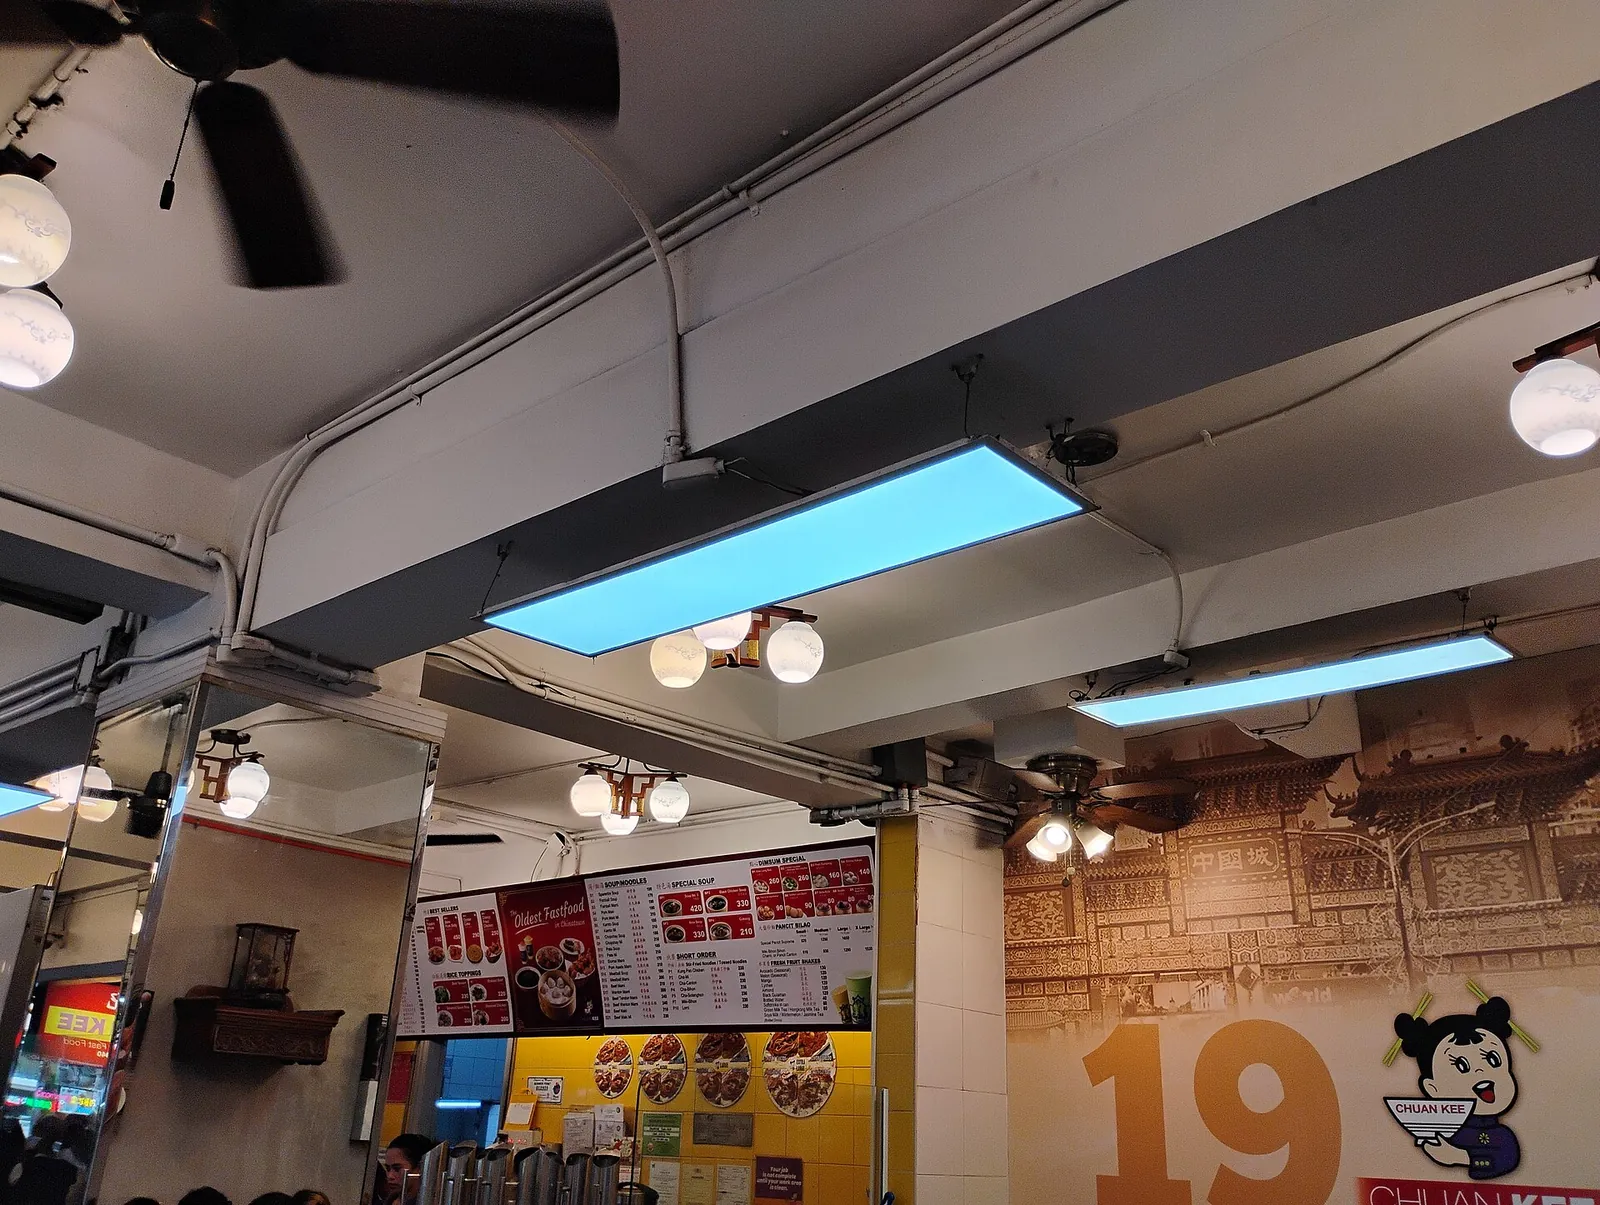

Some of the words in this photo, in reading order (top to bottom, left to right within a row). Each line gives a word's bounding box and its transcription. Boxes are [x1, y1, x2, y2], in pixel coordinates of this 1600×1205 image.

[672, 879, 697, 888] SPECIAL
[515, 911, 542, 928] Oldest
[544, 896, 584, 920] Fastfood
[1081, 1019, 1342, 1205] 19
[1395, 1104, 1437, 1114] CHUAN
[1441, 1105, 1466, 1114] KEE
